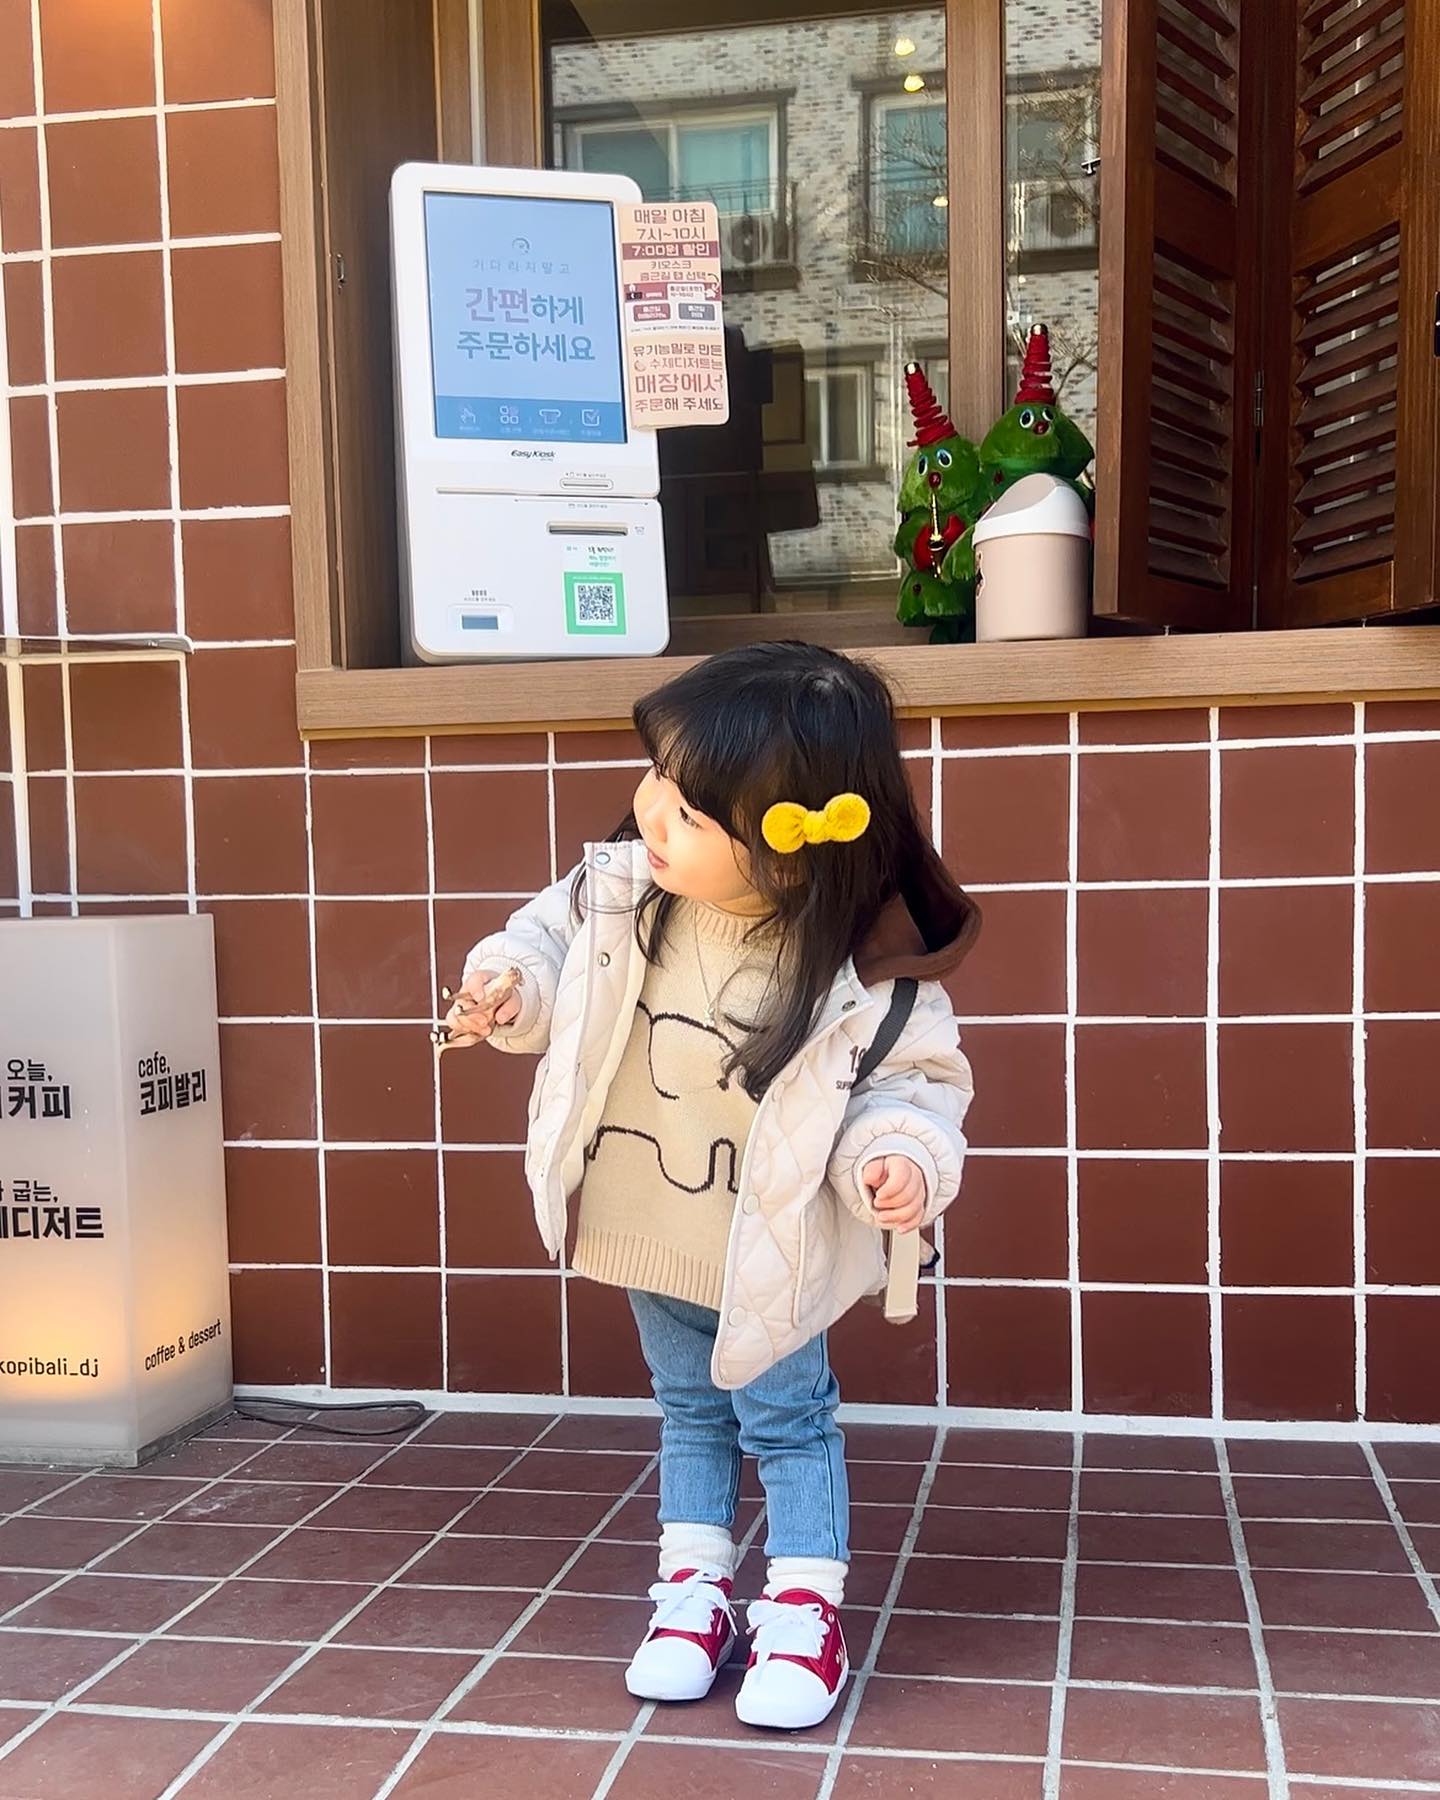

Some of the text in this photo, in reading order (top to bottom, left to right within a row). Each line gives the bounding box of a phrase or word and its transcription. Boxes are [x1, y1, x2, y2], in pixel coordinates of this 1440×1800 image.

[634, 208, 705, 224] 매일 아침
[636, 227, 706, 241] 7시~10시
[682, 243, 710, 256] 할인
[651, 261, 692, 269] 키오스크
[465, 287, 583, 325] 간편하게
[457, 331, 596, 362] 주문하세요
[650, 358, 723, 370] 수제디저트는
[635, 373, 723, 393] 매장에서
[635, 397, 724, 413] 주문해 주세요
[7, 1058, 53, 1082] 오늘,
[138, 1051, 171, 1078] cafe,
[0, 1085, 71, 1119] 커피
[140, 1069, 207, 1115] 코피발리
[13, 1180, 58, 1203] 굽는,
[145, 1319, 221, 1371] coffee & dessert
